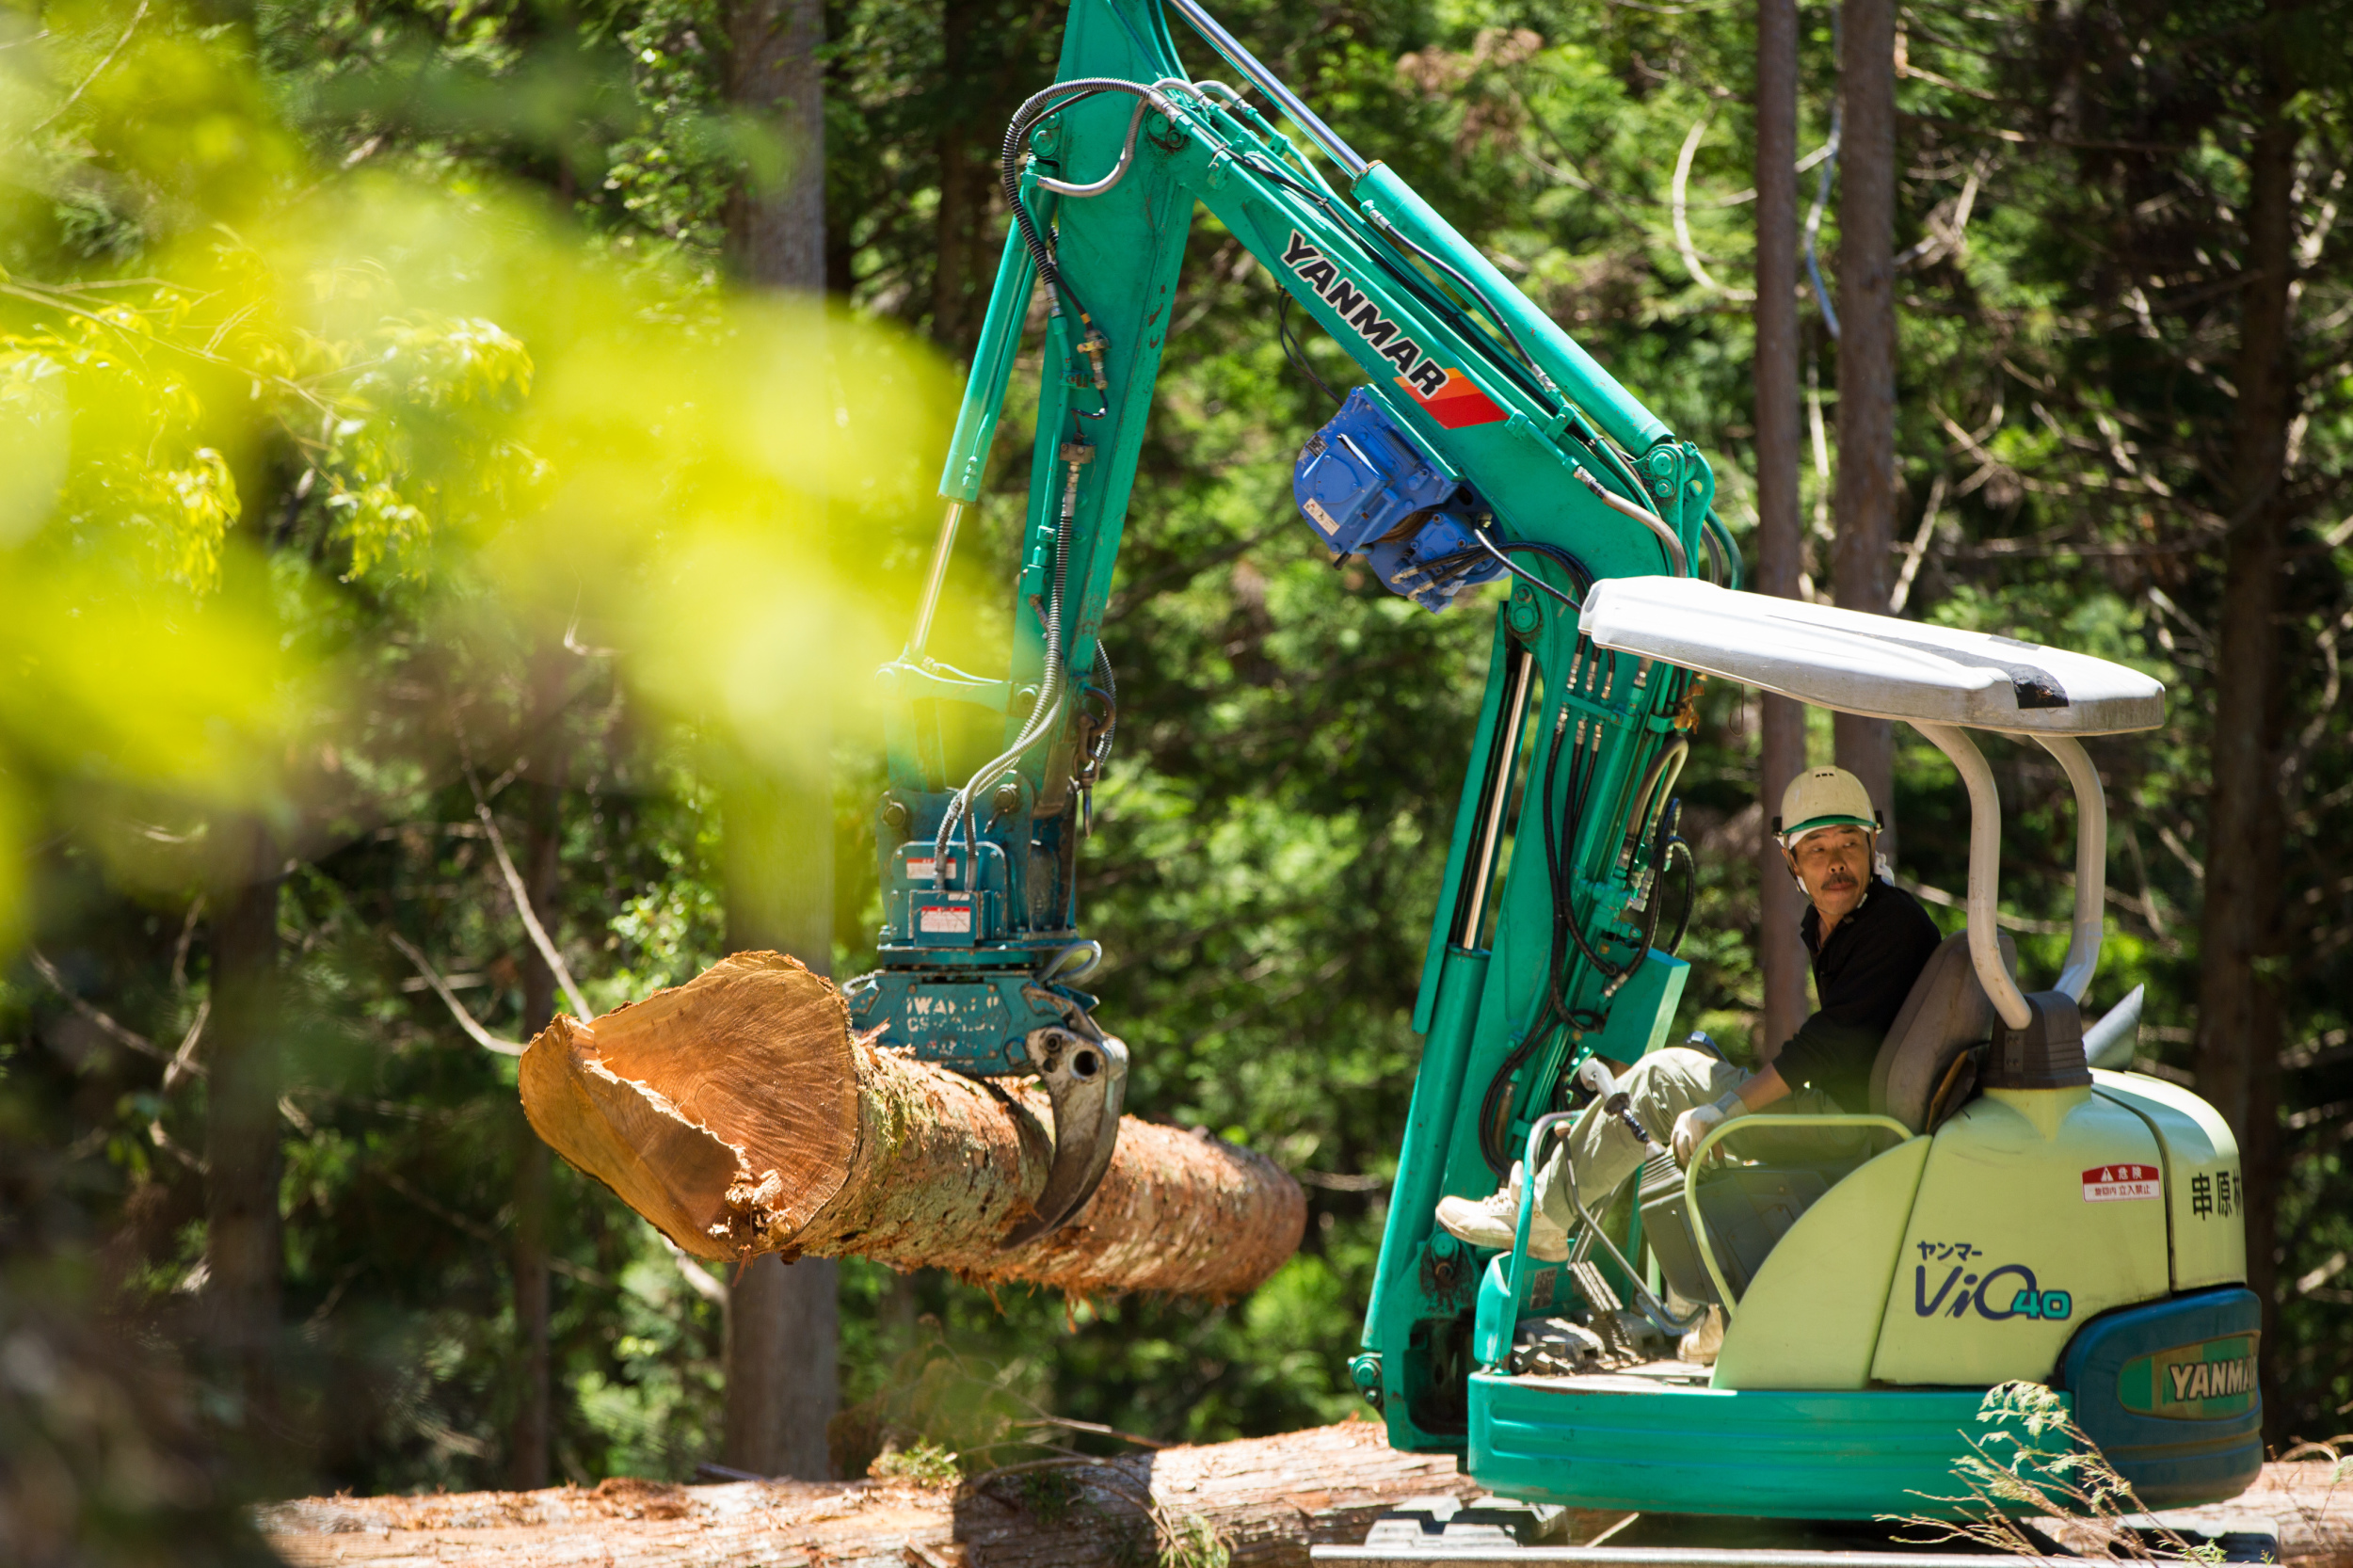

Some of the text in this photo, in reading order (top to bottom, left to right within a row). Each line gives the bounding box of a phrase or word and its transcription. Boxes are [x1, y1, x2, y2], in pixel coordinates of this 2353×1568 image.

[1281, 230, 1449, 398] YANMAR
[1916, 1240, 1982, 1261] ヤンマー
